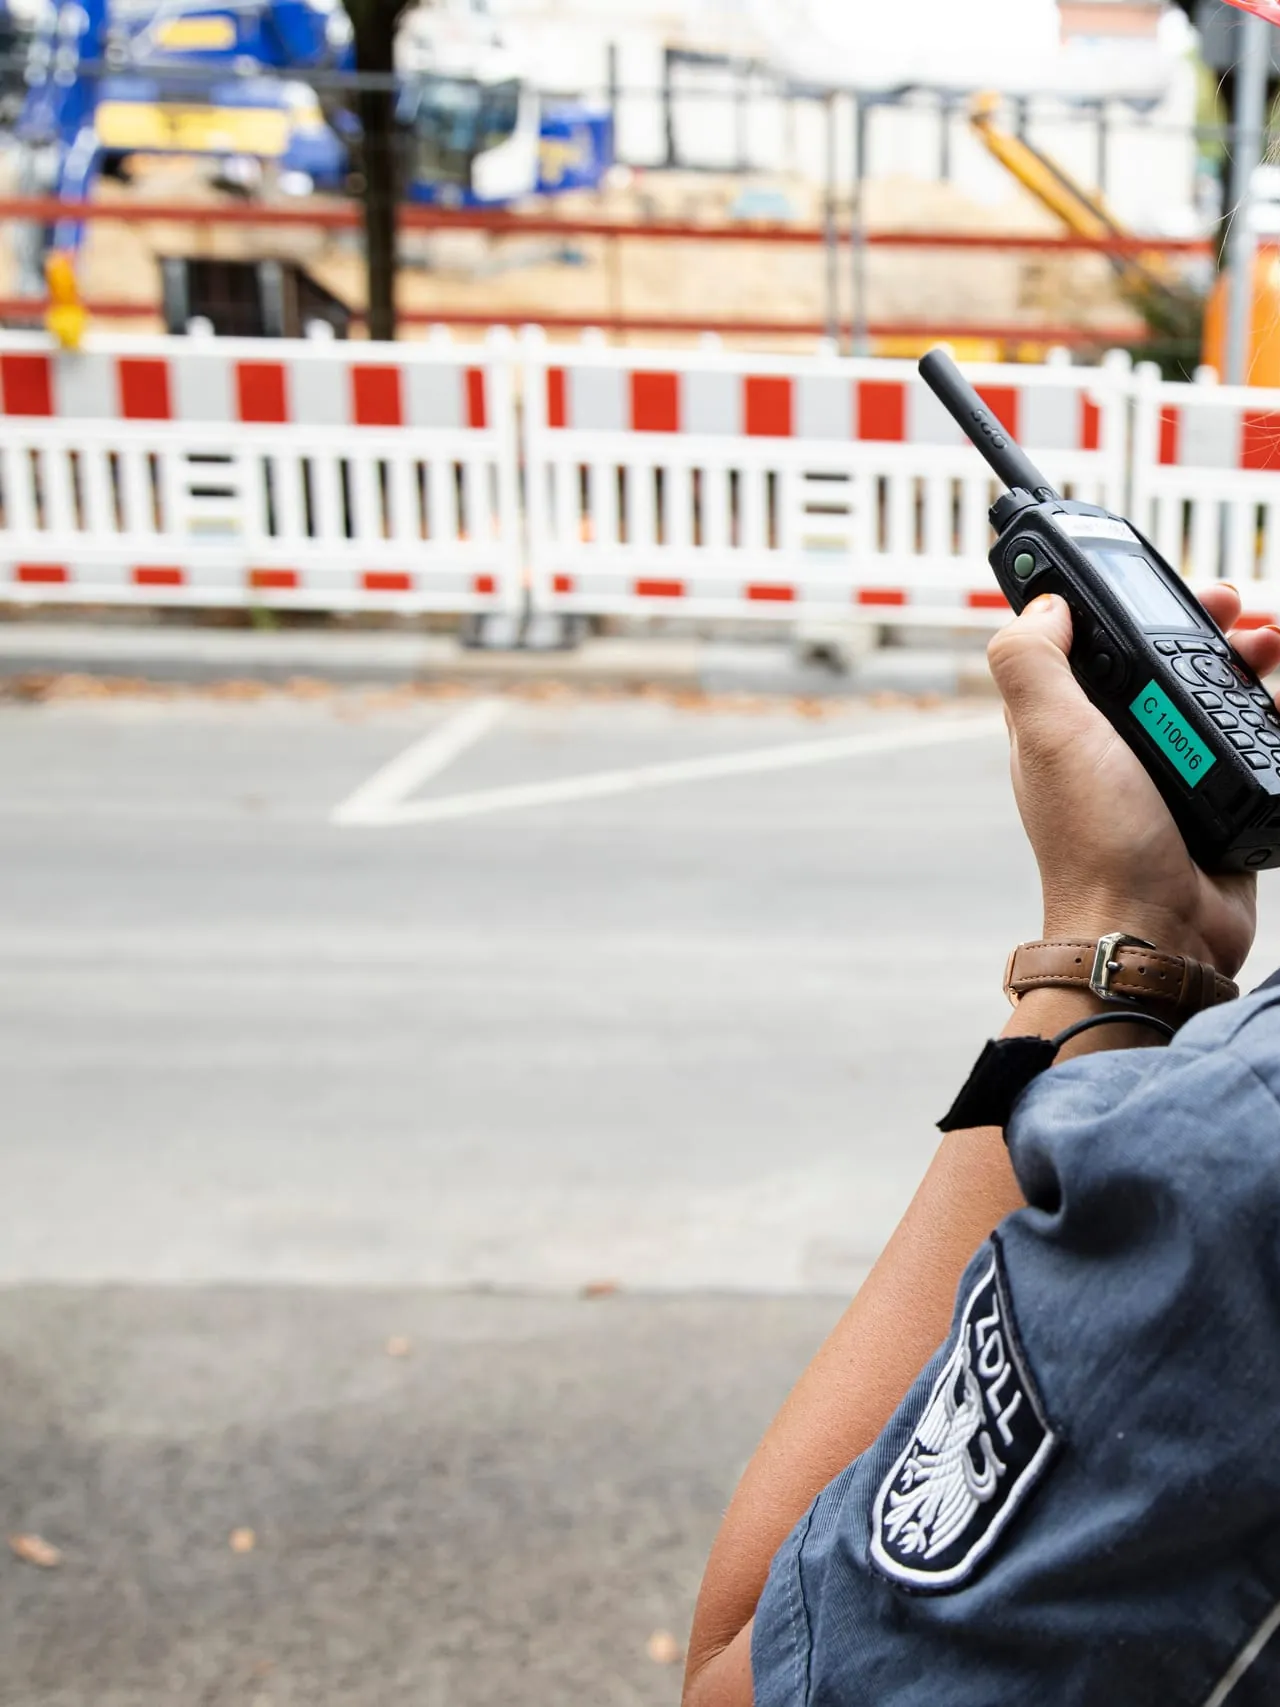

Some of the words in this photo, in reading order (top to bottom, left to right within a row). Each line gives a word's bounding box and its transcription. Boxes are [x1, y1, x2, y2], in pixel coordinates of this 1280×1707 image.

[1143, 697, 1158, 714] C
[1156, 712, 1203, 770] 110016
[976, 1292, 1022, 1446] ZOLL
